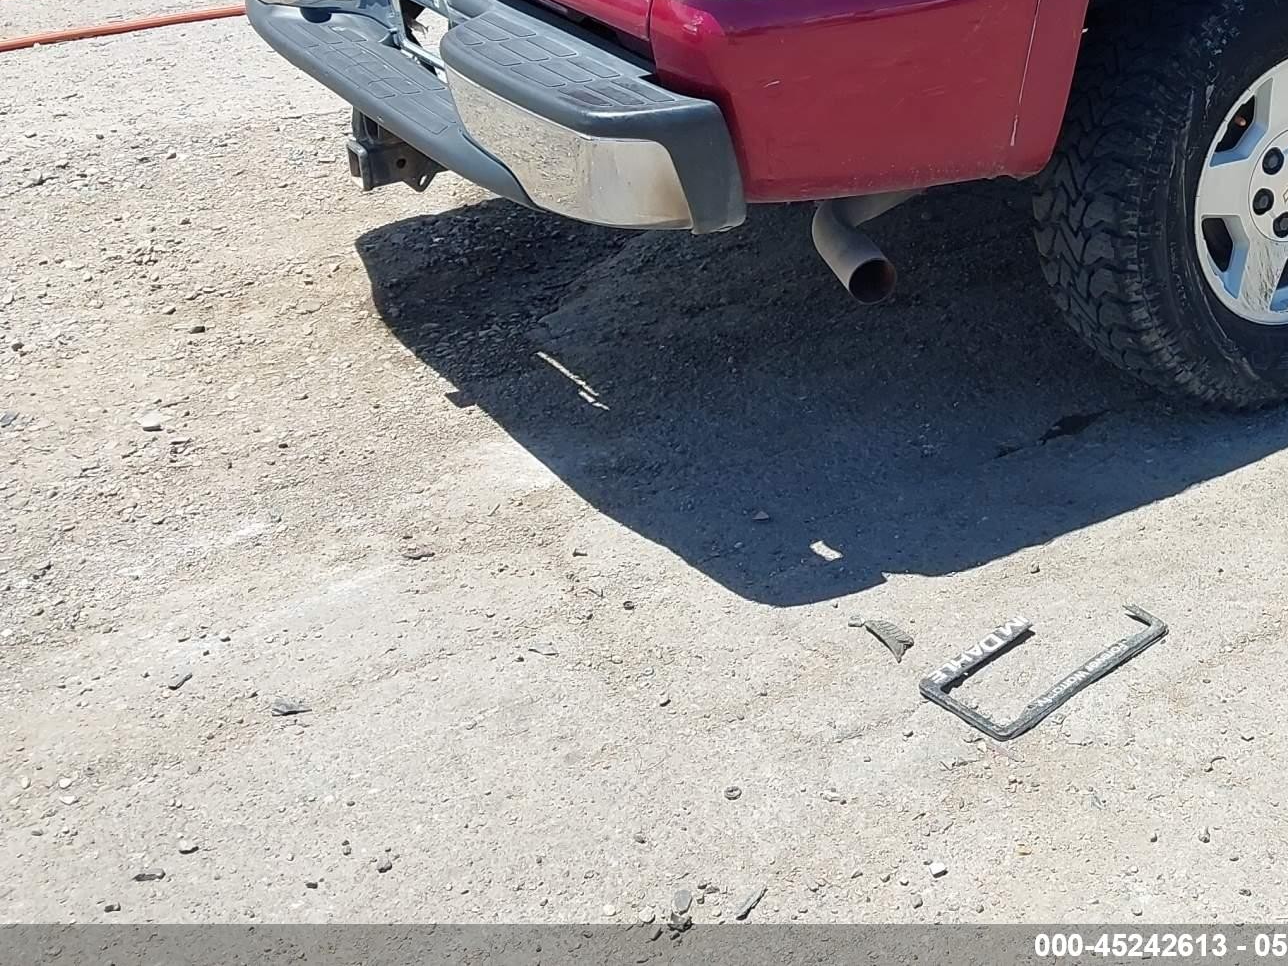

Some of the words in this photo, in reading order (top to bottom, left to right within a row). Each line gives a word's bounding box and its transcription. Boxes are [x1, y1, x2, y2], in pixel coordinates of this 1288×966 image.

[927, 632, 1005, 684] DAHLE
[1085, 642, 1128, 672] Forever
[1036, 670, 1091, 707] Warranty
